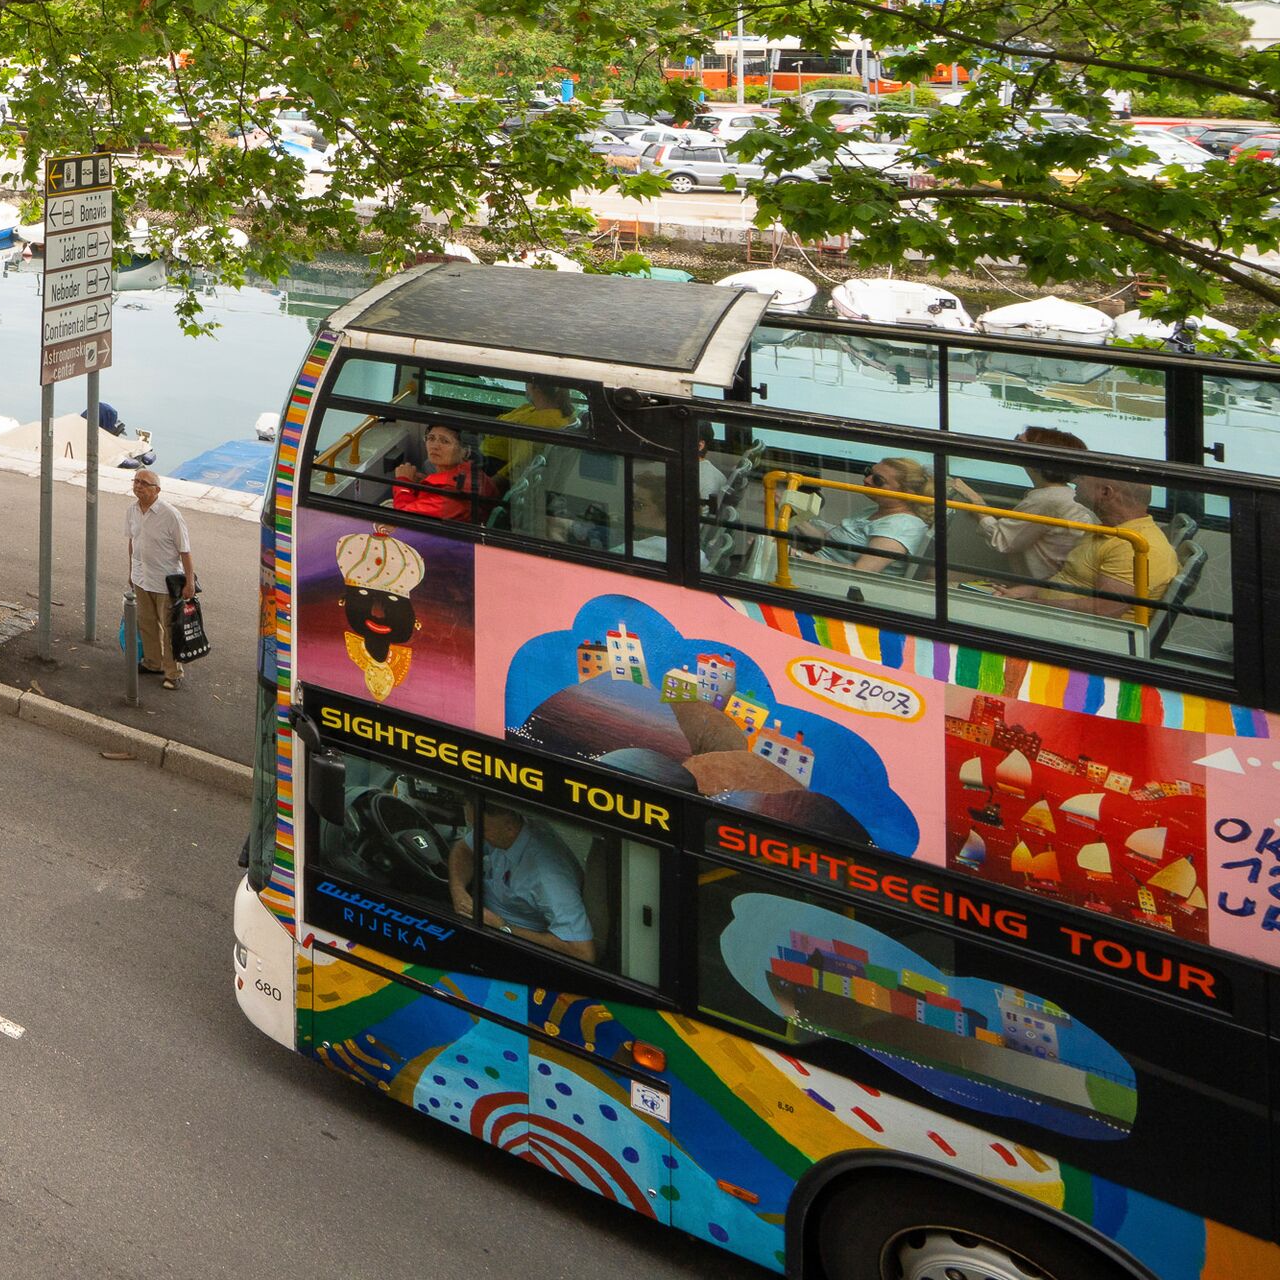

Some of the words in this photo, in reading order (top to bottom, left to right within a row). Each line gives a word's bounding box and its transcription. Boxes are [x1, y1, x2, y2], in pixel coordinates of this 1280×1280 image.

[80, 202, 107, 222] Bonavia
[60, 244, 86, 263] Jadran
[51, 280, 81, 303] Neboder
[44, 314, 86, 341] Continental
[43, 341, 87, 367] Astronomski
[53, 363, 76, 380] centar
[320, 706, 544, 792] SIGHTSEEING
[564, 778, 671, 831] TOUR
[717, 825, 1028, 940] SIGHTSEEING
[1060, 926, 1217, 998] TOUR
[343, 907, 427, 951] RIJEKA
[255, 979, 282, 1001] 680
